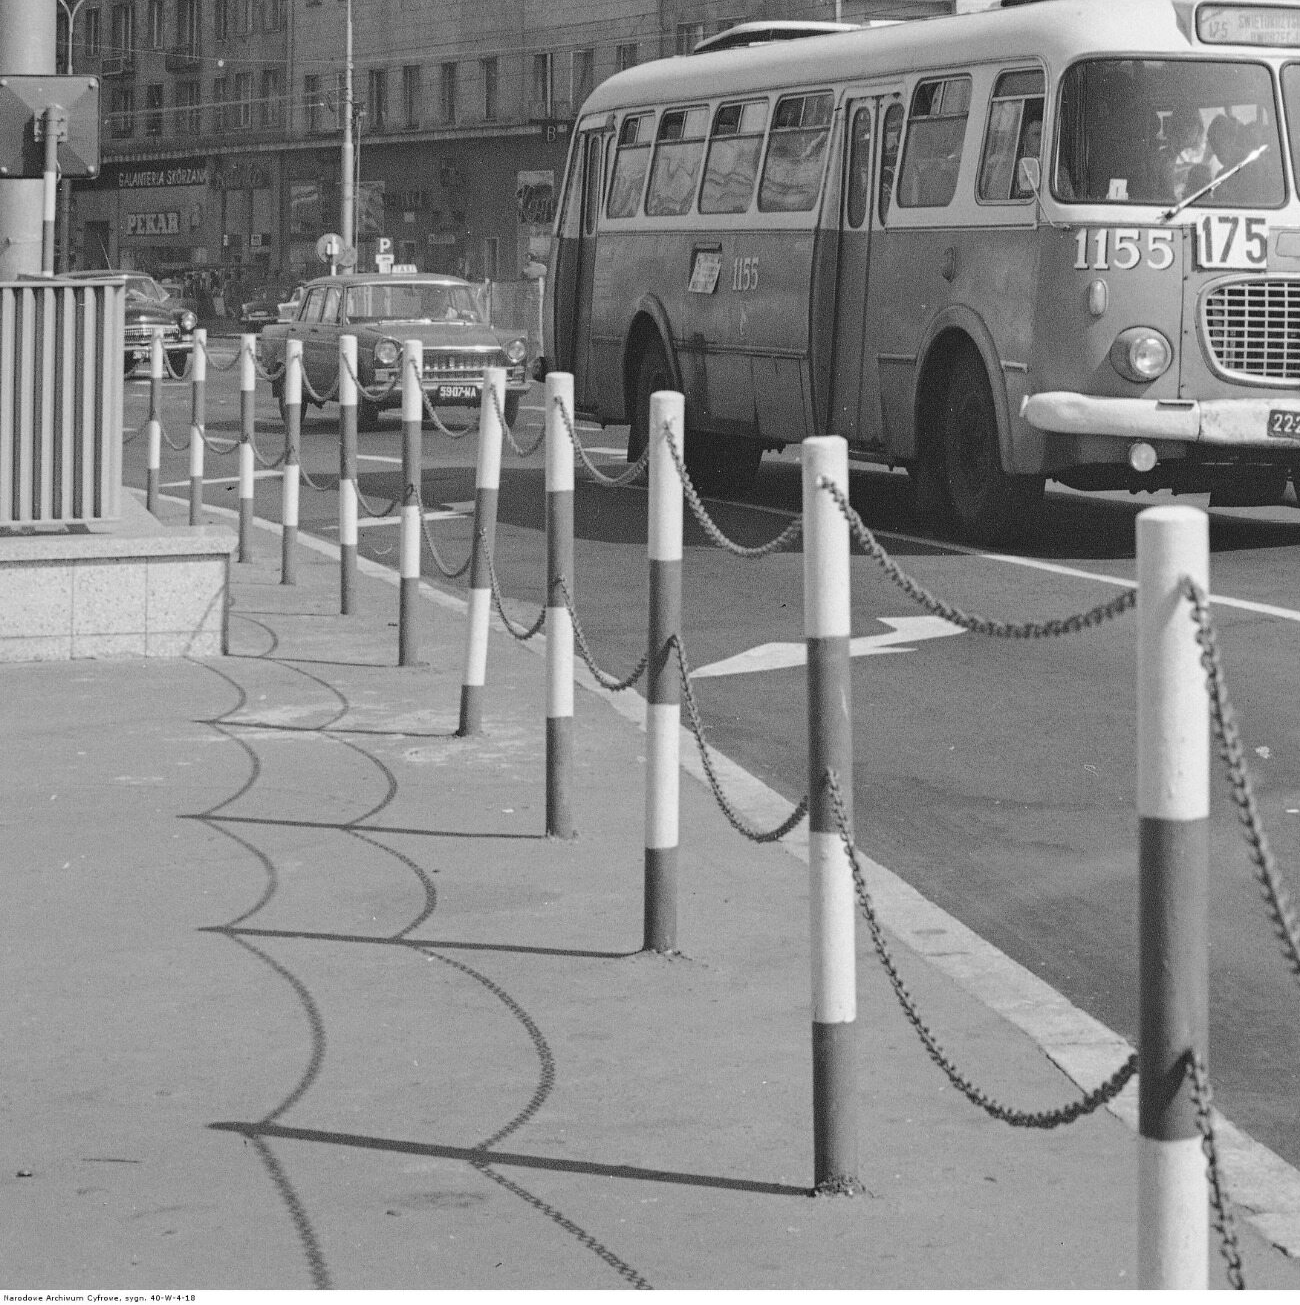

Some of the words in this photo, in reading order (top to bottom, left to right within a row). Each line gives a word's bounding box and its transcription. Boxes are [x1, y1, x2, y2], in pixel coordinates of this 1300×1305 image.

[1208, 21, 1228, 39] 175
[118, 170, 164, 187] GALANTERIA
[379, 238, 391, 253] P
[1074, 228, 1175, 270] 1155
[1201, 215, 1268, 264] 175
[732, 257, 760, 291] 1155
